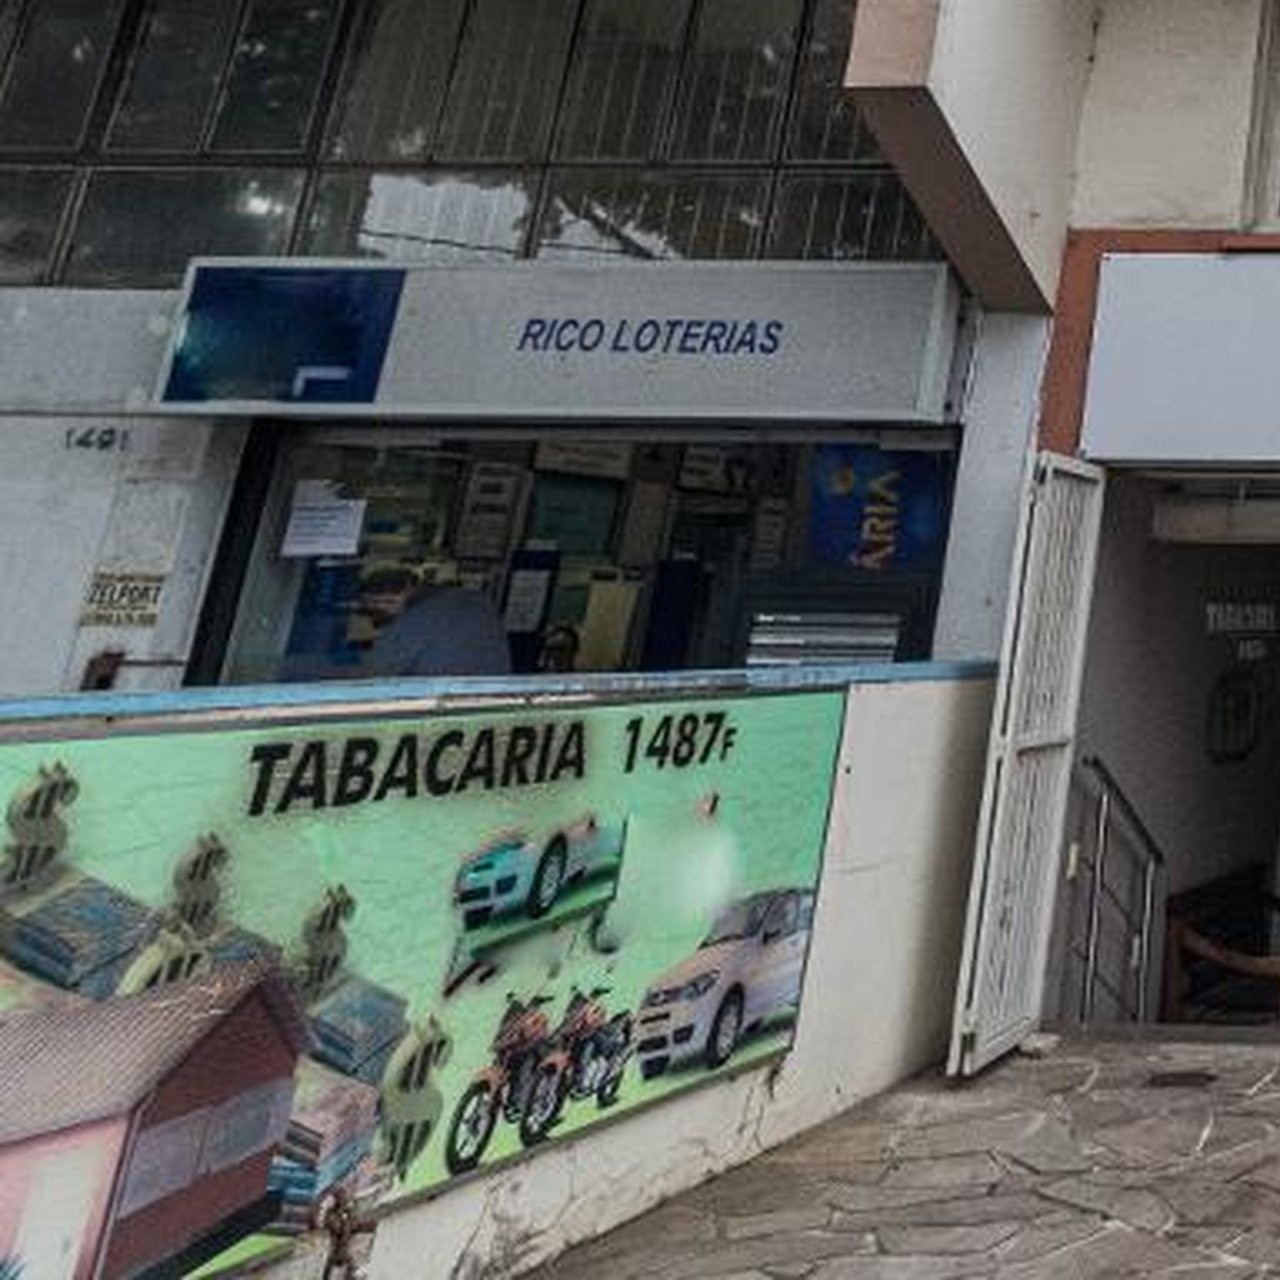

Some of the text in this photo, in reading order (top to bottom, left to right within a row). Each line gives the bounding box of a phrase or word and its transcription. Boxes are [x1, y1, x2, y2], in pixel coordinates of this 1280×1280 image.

[516, 318, 784, 355] RICO LOTERIAS
[245, 720, 587, 818] TABACARIA
